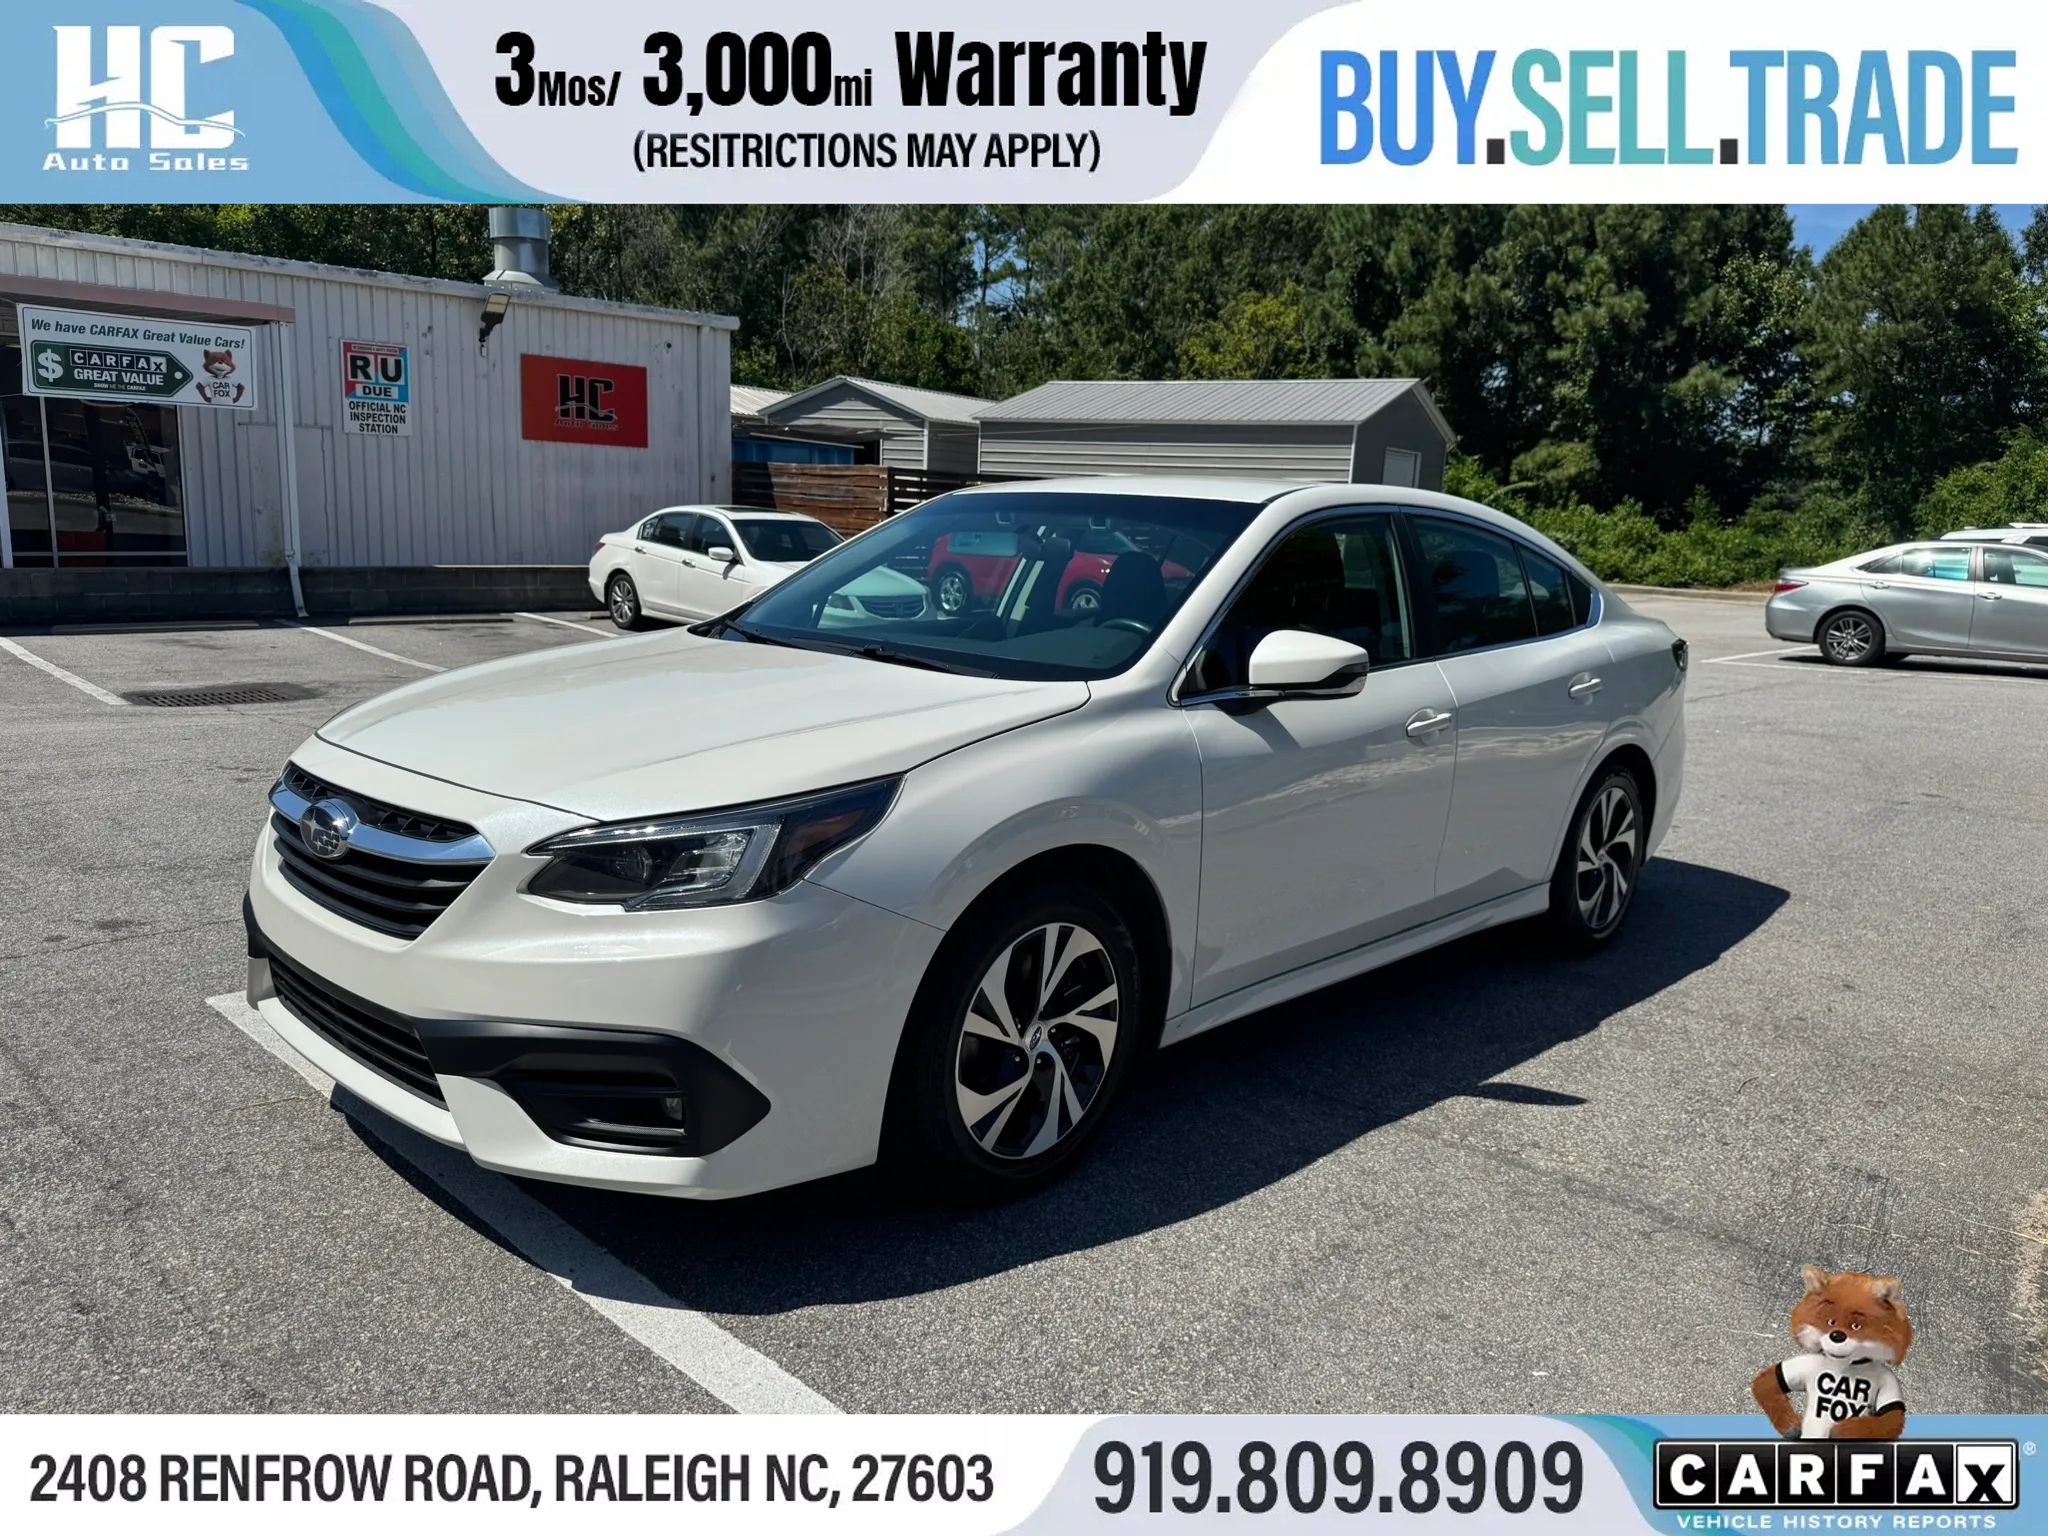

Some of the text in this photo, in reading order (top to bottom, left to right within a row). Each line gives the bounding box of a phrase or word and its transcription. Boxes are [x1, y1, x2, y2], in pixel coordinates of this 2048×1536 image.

[31, 318, 245, 349] We have CARFAX Great Value Cars!
[72, 350, 165, 373] CARFAX
[74, 368, 164, 385] GREAT VALUE
[362, 385, 392, 397] DUE
[557, 374, 615, 422] HC
[349, 401, 406, 413] OFFICIAL NC
[350, 412, 406, 424] INSPECTION
[359, 423, 398, 434] STATION
